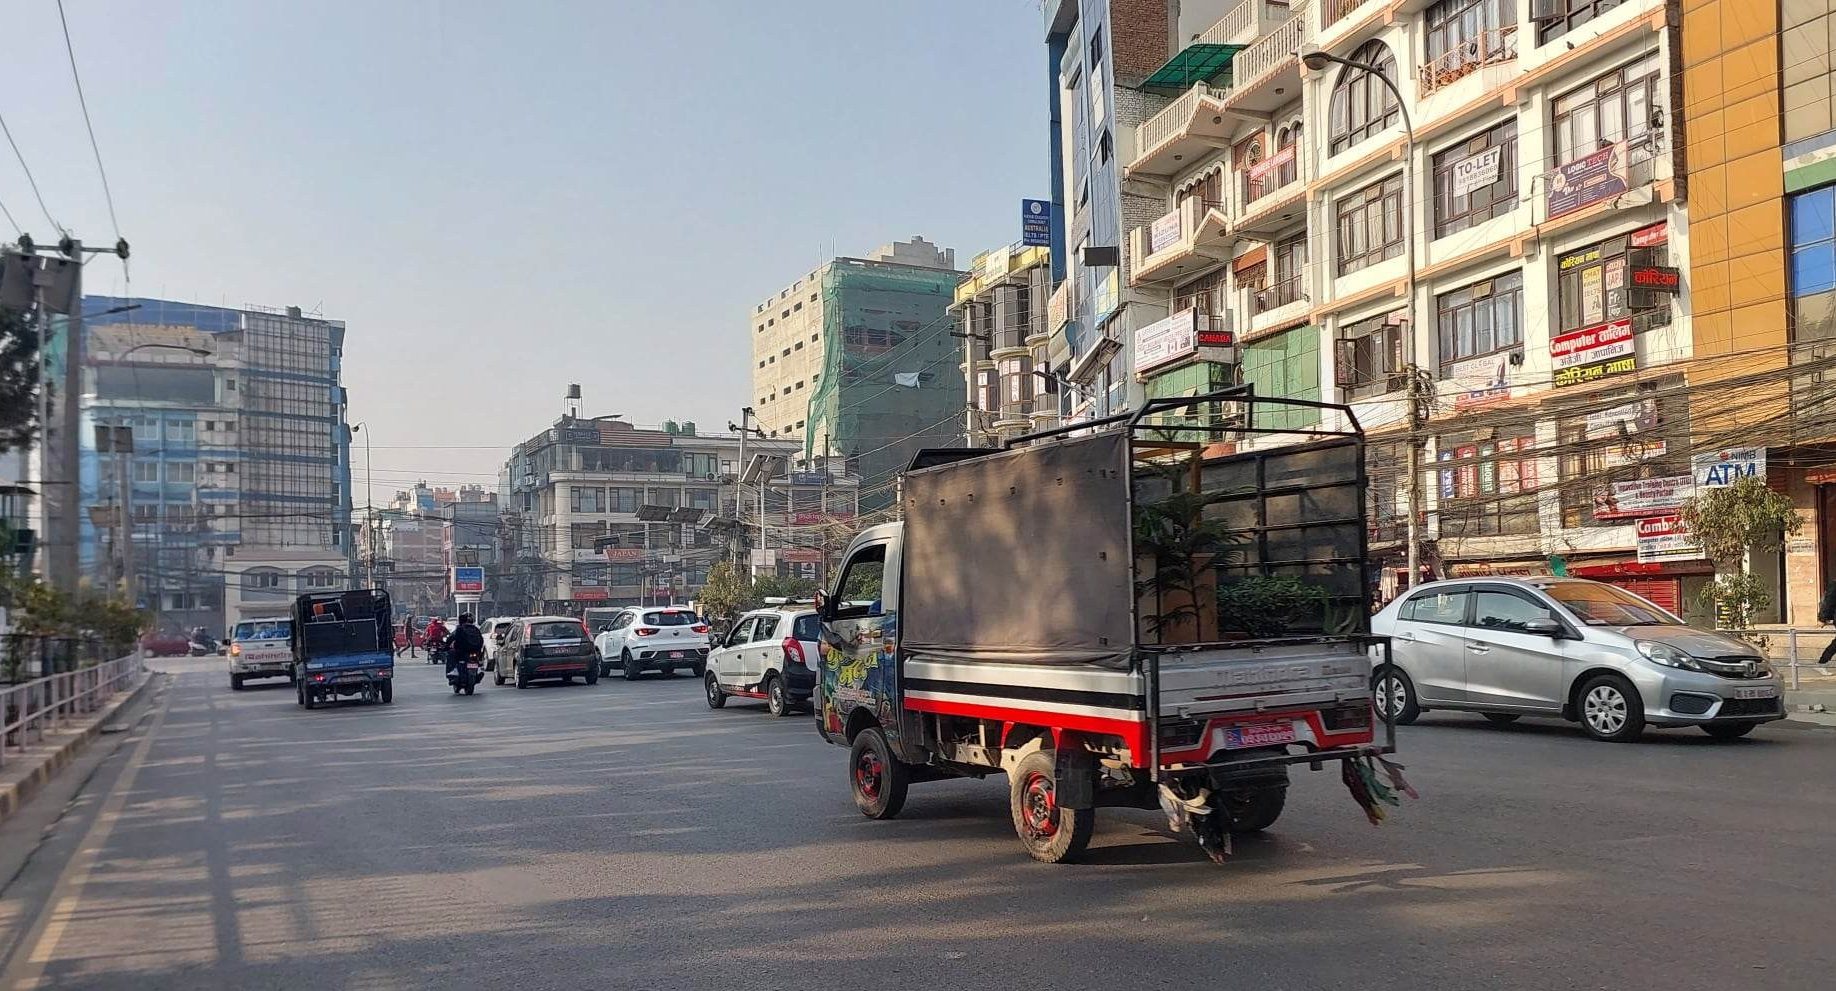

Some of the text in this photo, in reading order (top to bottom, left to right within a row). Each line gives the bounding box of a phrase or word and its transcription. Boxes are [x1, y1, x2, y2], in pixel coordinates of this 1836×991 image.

[1458, 151, 1498, 176] TO-LET
[1567, 151, 1609, 174] LOGIC TECH
[1024, 224, 1049, 232] AUSTRALIA
[1634, 268, 1678, 286] कोरियन
[1199, 333, 1231, 343] CANADA
[1549, 333, 1596, 354] Computer
[1554, 358, 1637, 386] कोरियन भाषा
[1731, 450, 1757, 460] NIMB
[1445, 469, 1453, 493] USA
[1705, 463, 1756, 485] ATM
